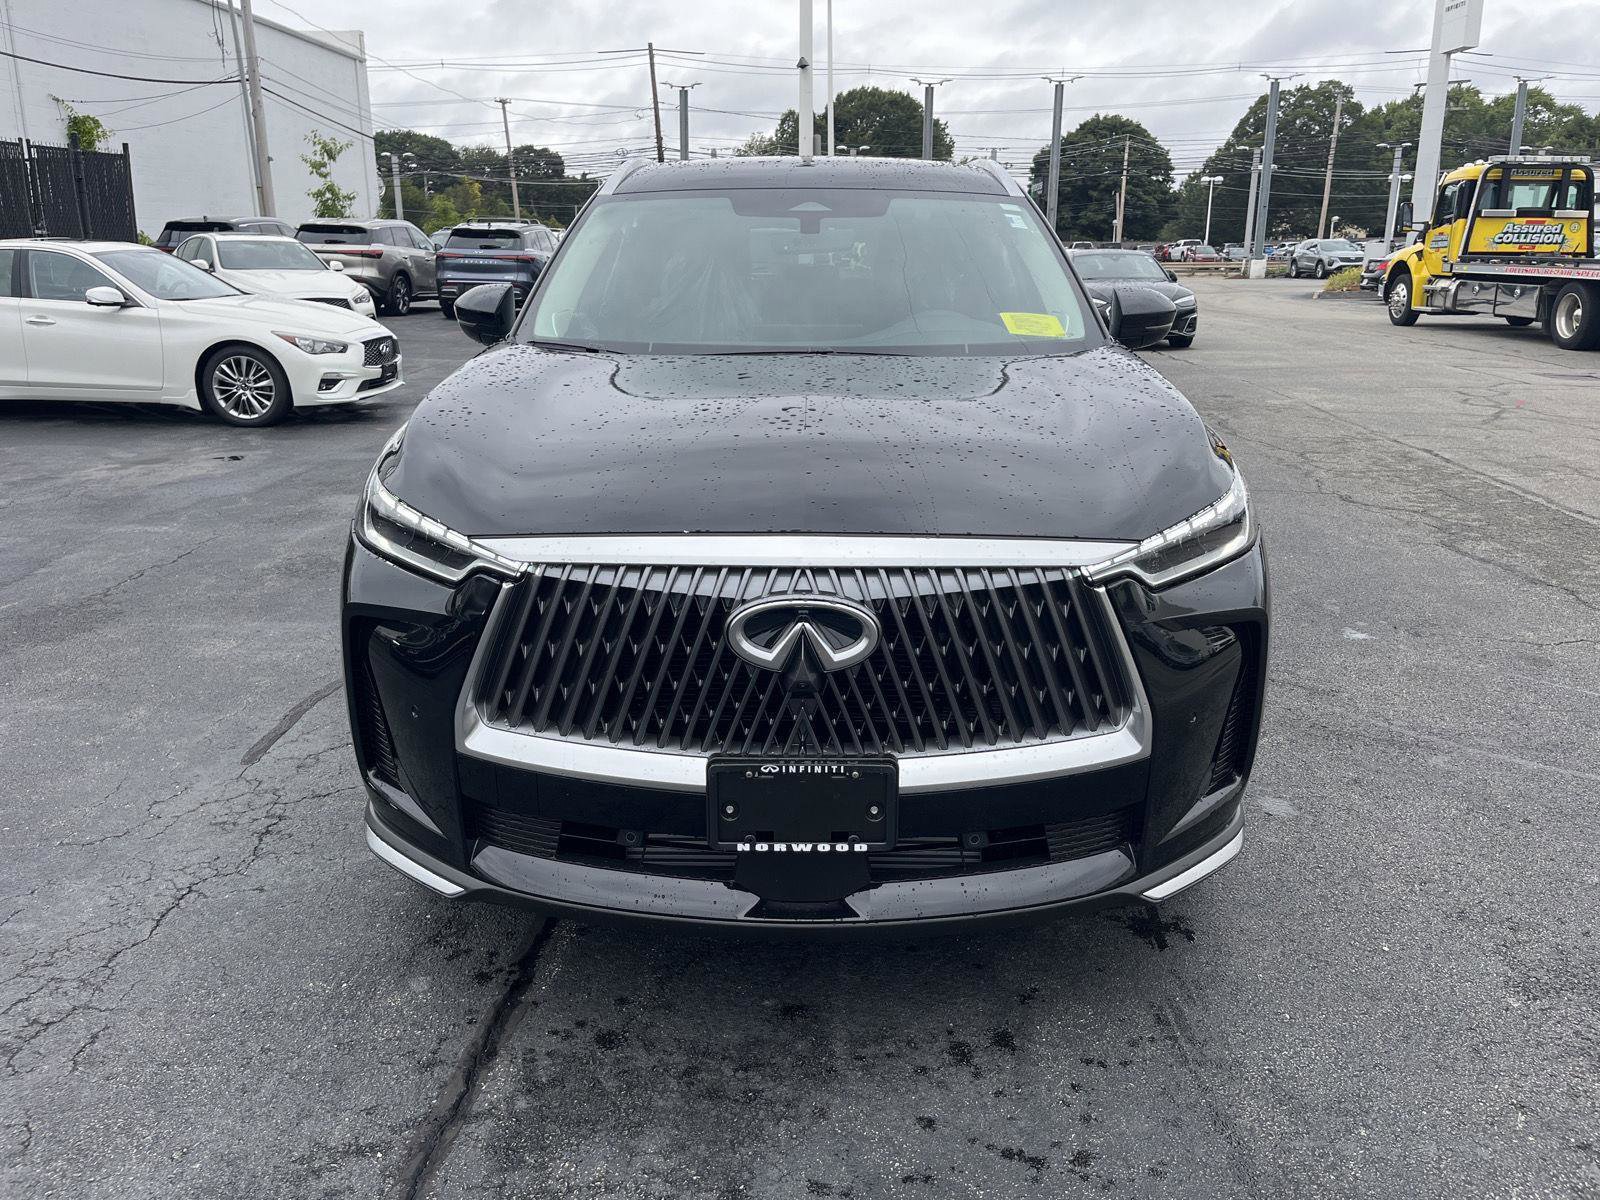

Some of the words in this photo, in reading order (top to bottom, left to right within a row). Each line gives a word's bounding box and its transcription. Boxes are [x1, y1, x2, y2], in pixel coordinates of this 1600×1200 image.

[1502, 222, 1564, 234] Assured
[1493, 233, 1566, 244] COLLISION
[782, 765, 845, 774] INFINITI
[736, 843, 868, 852] NORWOOD
